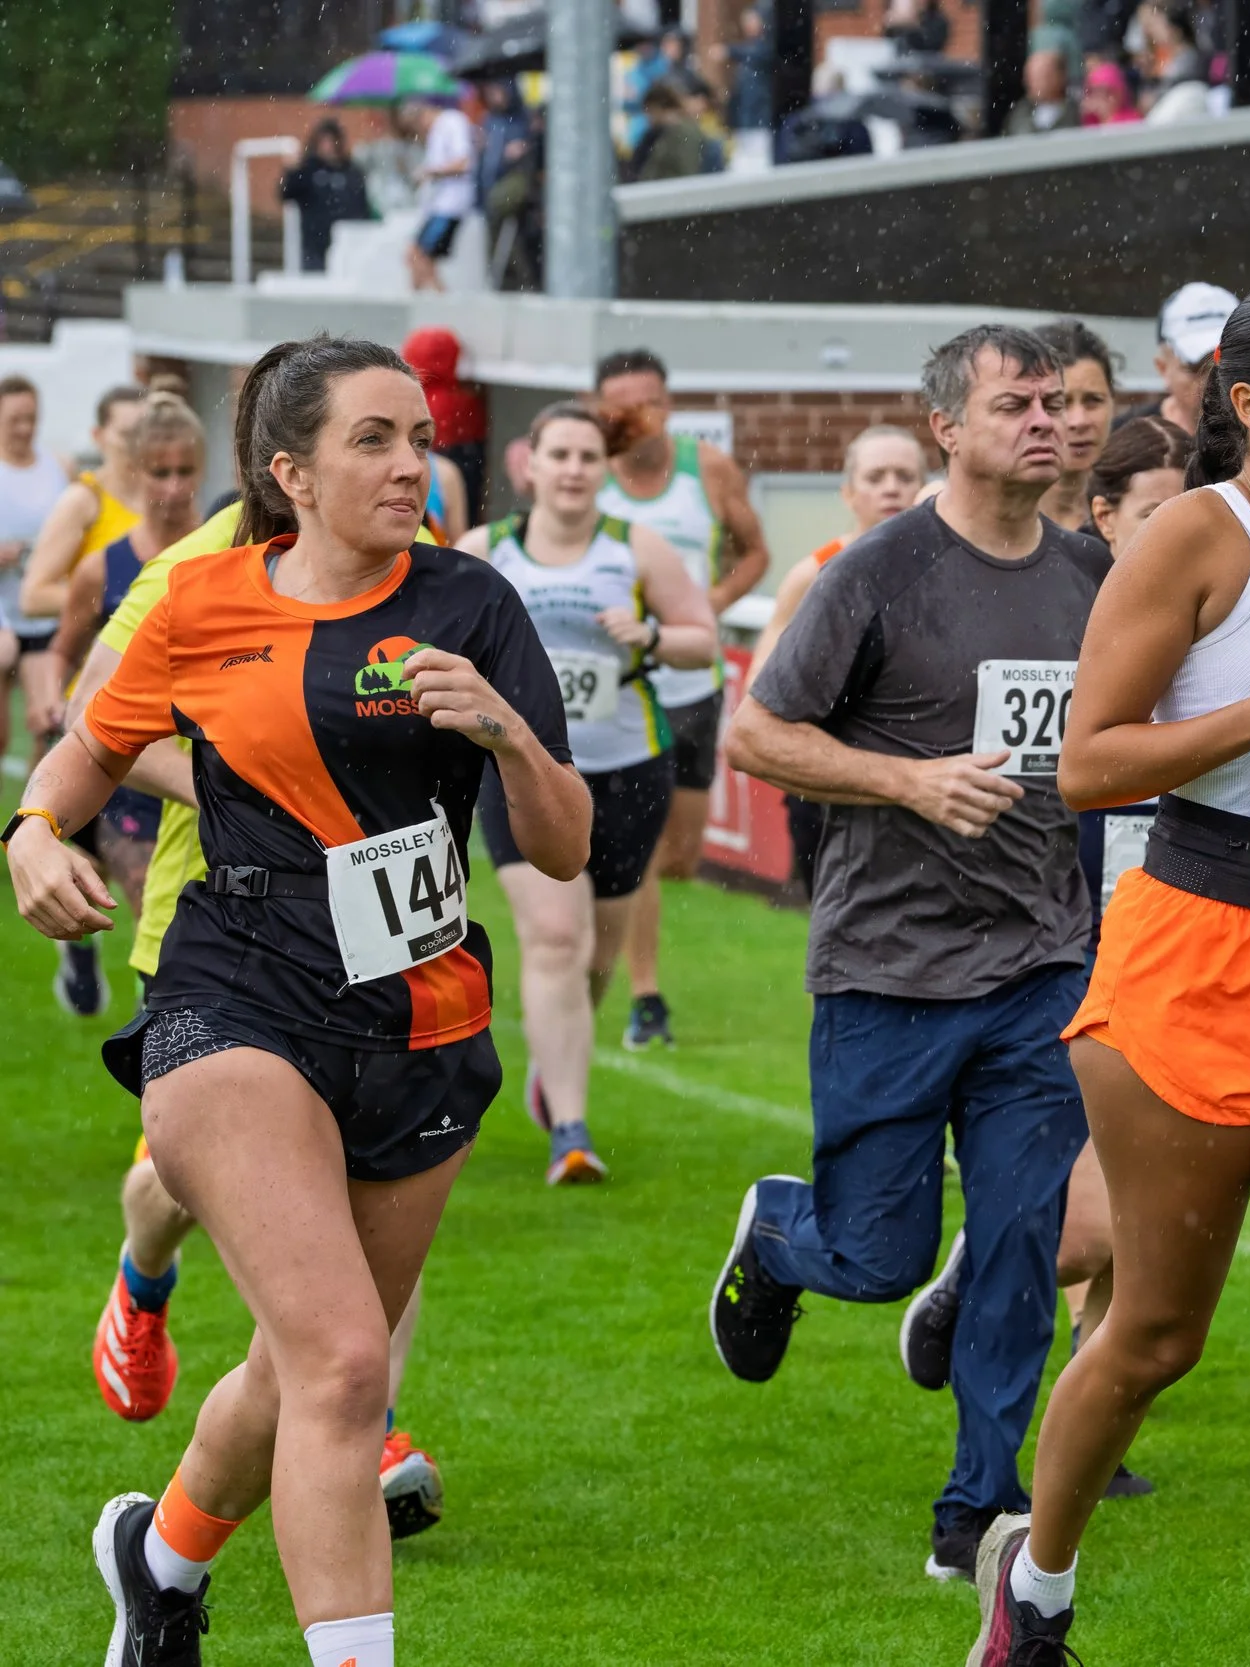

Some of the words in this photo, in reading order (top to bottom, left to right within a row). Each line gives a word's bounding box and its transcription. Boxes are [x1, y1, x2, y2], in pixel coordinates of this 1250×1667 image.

[219, 644, 274, 671] FASTRAX
[559, 669, 598, 705] 39
[1002, 669, 1061, 681] MOSSLEY
[1065, 670, 1077, 682] 10
[355, 699, 420, 718] MOSS
[350, 829, 435, 866] MOSSLEY
[372, 839, 463, 937] 144
